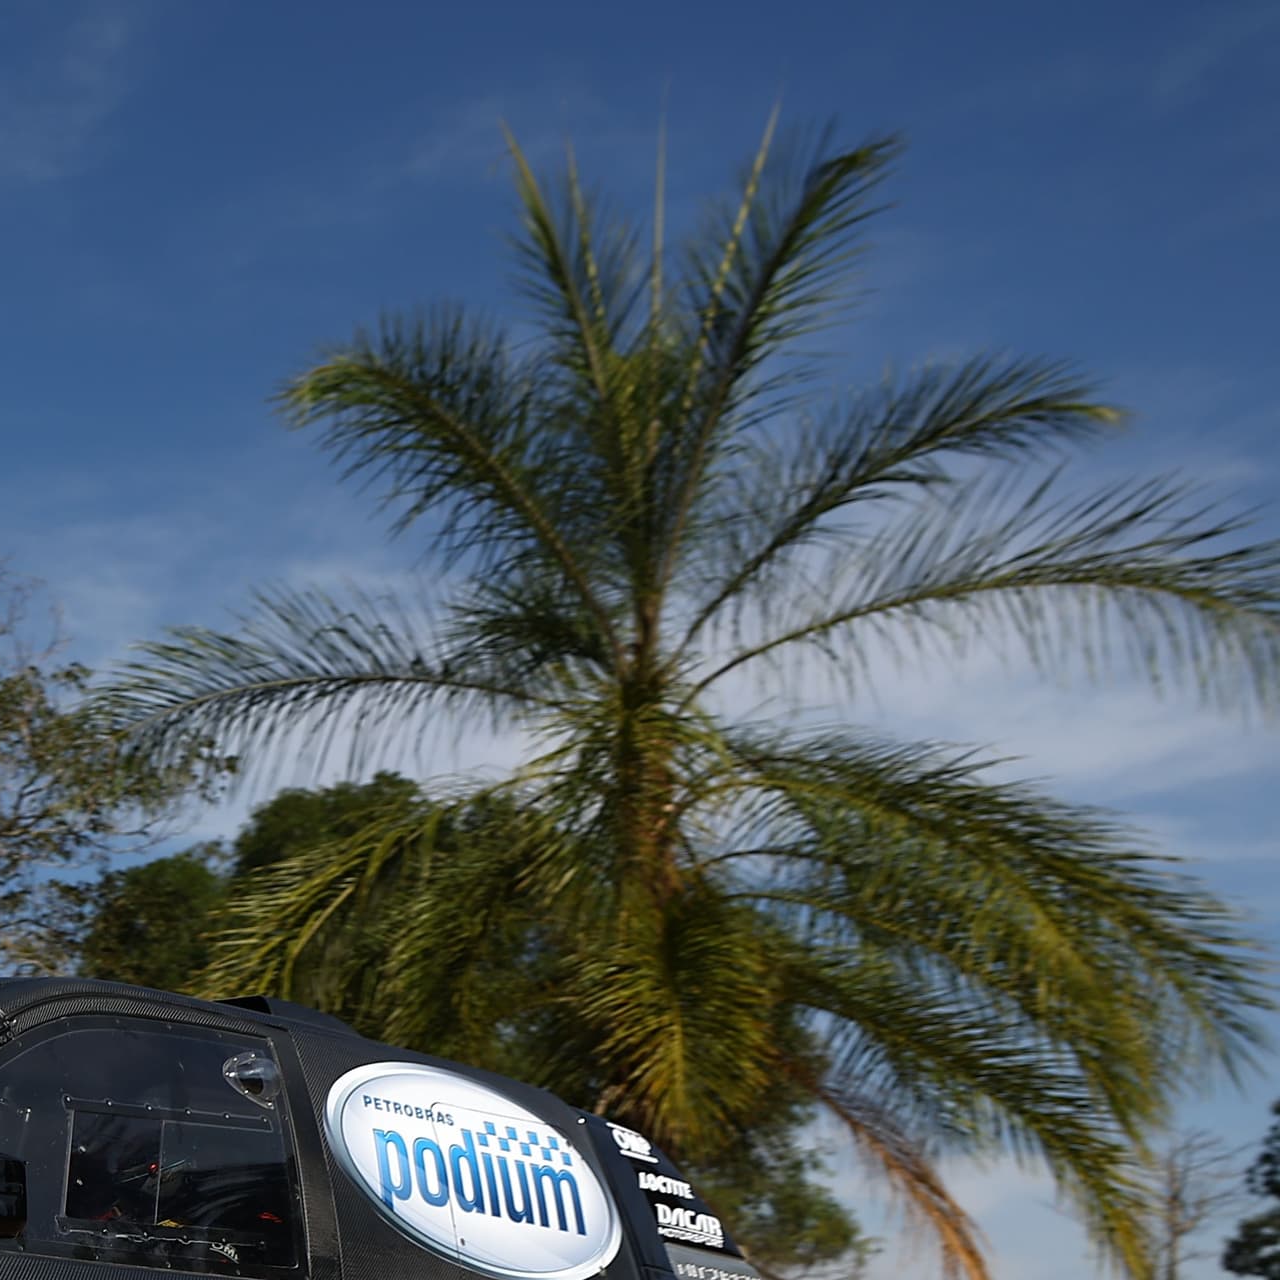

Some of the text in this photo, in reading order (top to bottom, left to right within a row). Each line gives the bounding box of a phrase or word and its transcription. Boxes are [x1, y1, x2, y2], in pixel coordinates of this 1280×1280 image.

[362, 1094, 455, 1127] PETROBRAS
[372, 1127, 588, 1237] podium
[638, 1171, 695, 1200] LOCTITE
